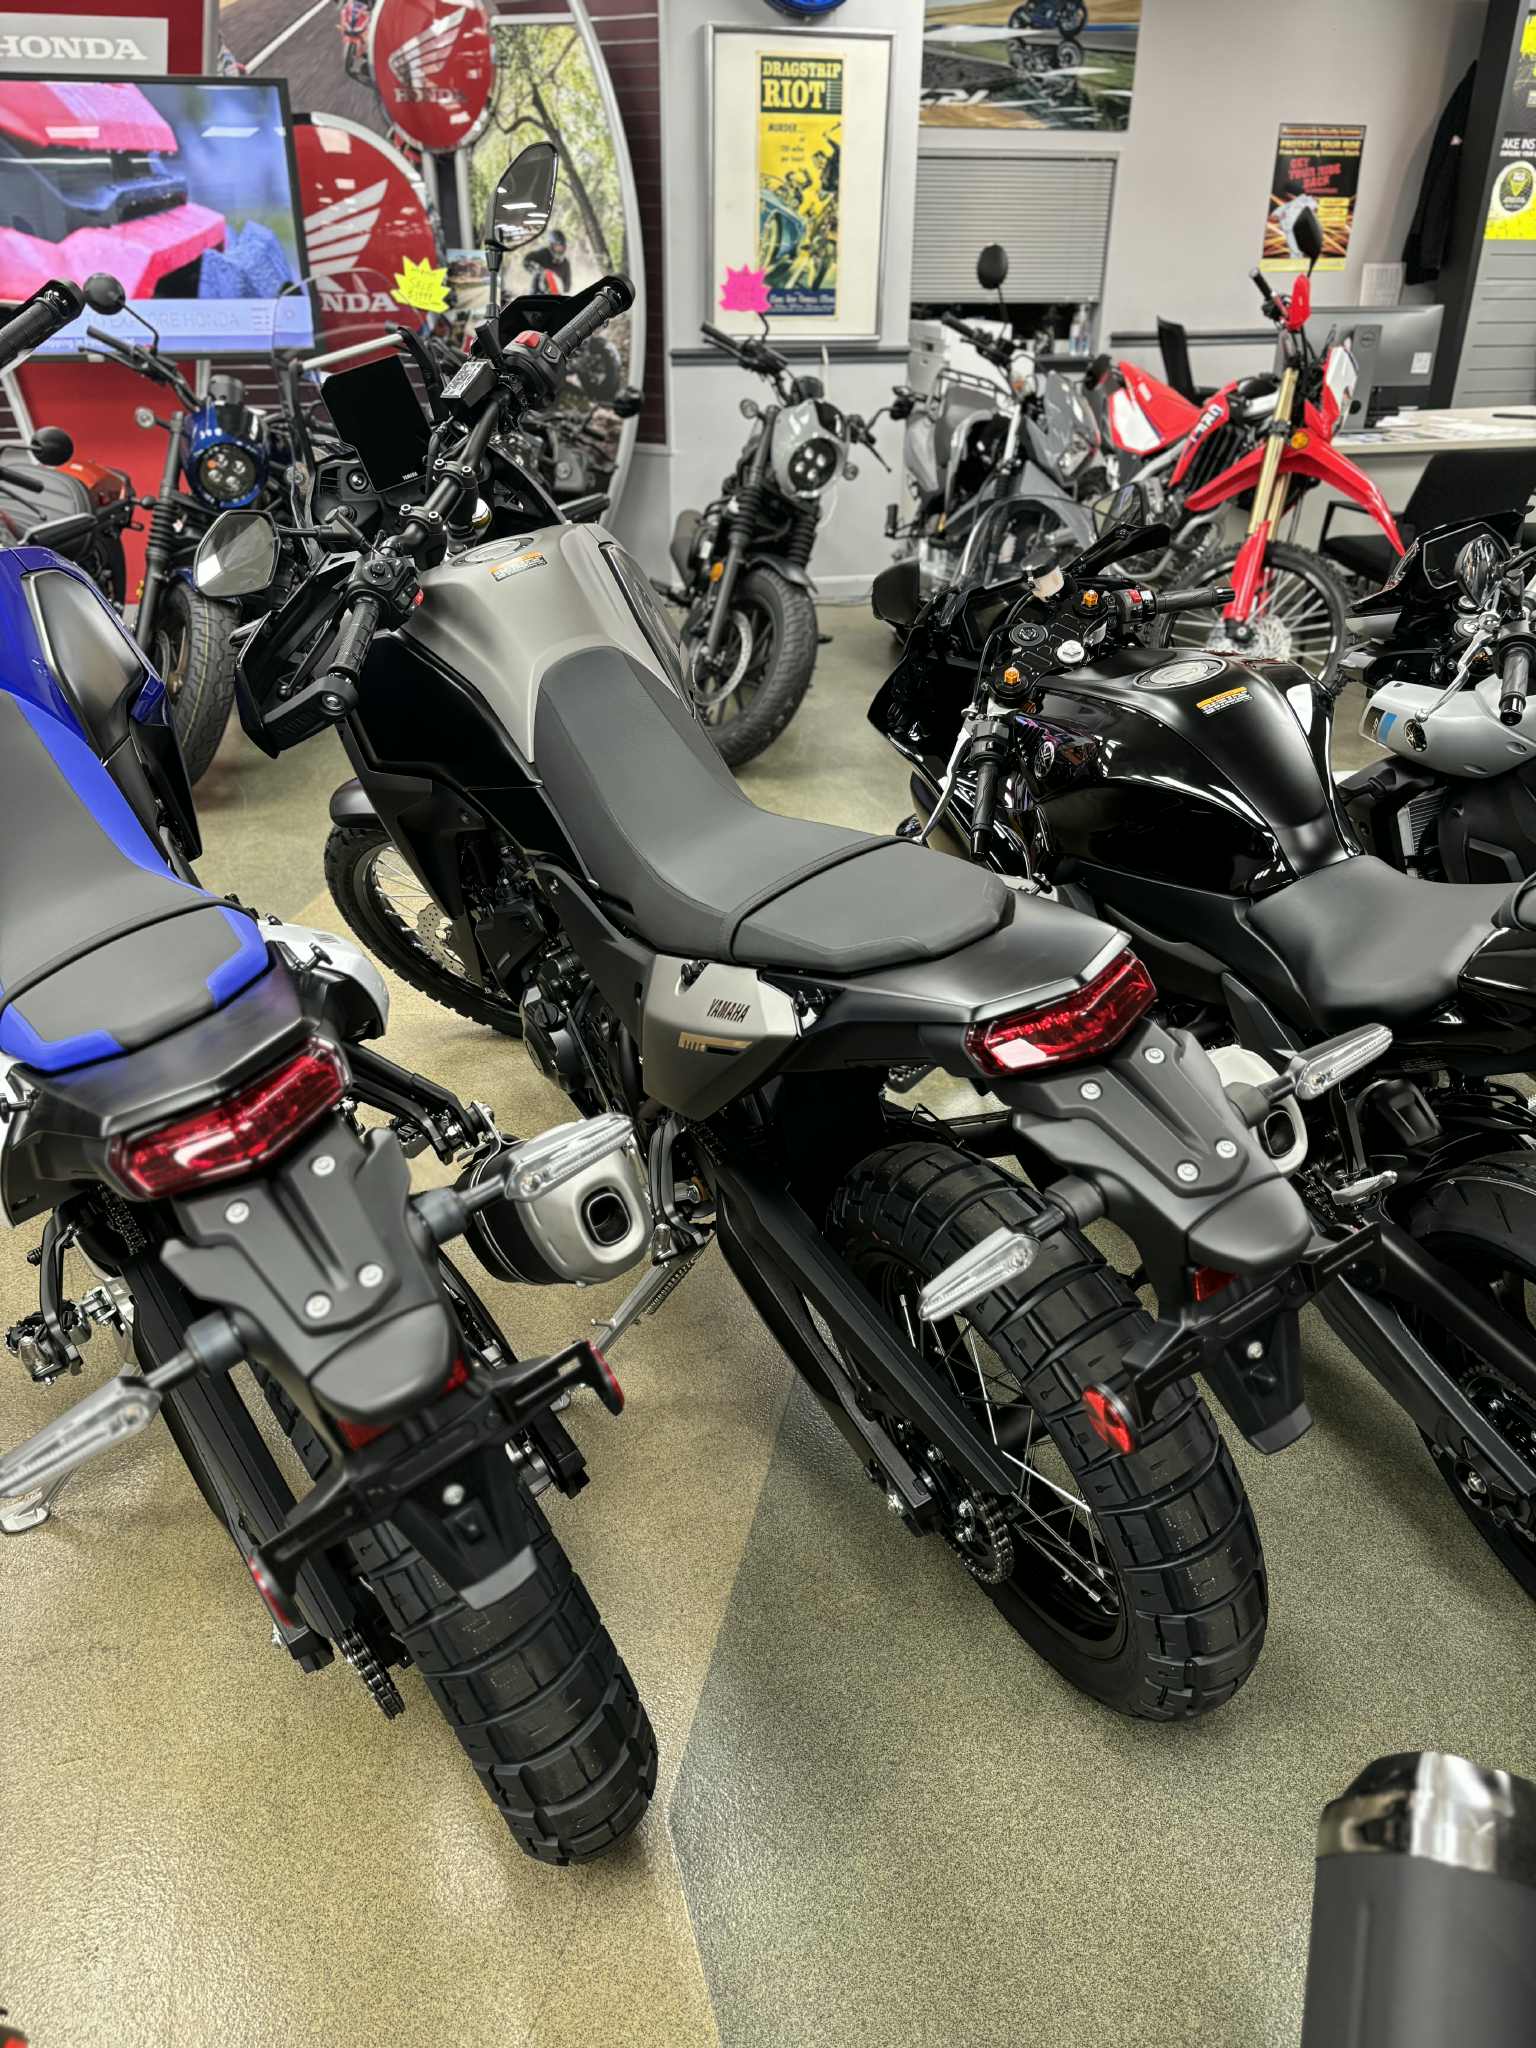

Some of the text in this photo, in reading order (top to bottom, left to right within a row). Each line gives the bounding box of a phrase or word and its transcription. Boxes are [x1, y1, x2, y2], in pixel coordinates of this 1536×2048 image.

[0, 36, 148, 60] HONDA
[762, 61, 841, 78] DRAGSTRIP
[763, 79, 826, 109] RIOT
[321, 292, 399, 312] NDA
[706, 998, 751, 1023] YAMAHA
